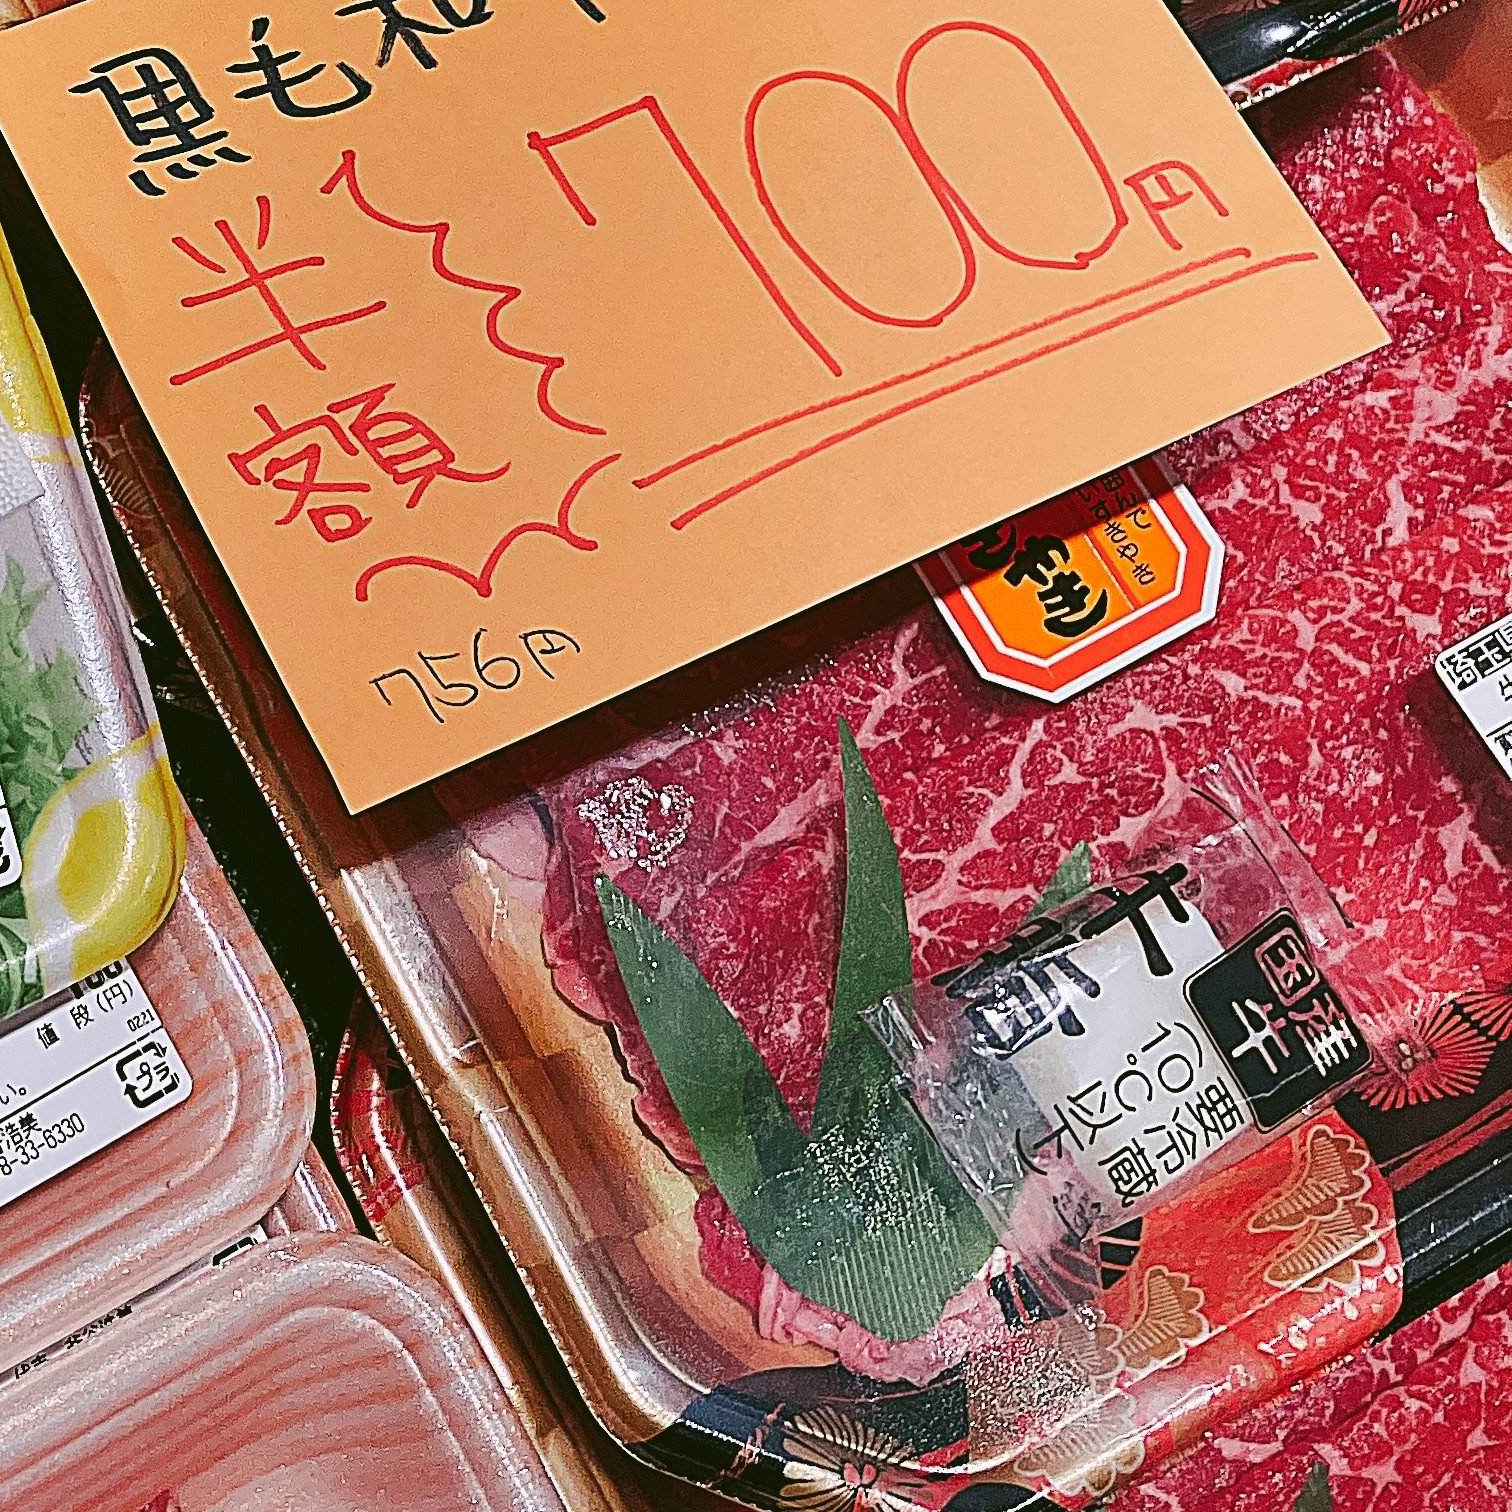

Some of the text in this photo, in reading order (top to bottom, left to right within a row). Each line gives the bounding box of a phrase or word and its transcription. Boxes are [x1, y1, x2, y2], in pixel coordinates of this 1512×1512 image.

[527, 22, 1233, 378] 700円
[170, 194, 511, 542] 半額
[370, 628, 583, 726] 756円
[1097, 1076, 1245, 1208] 要冷蔵
